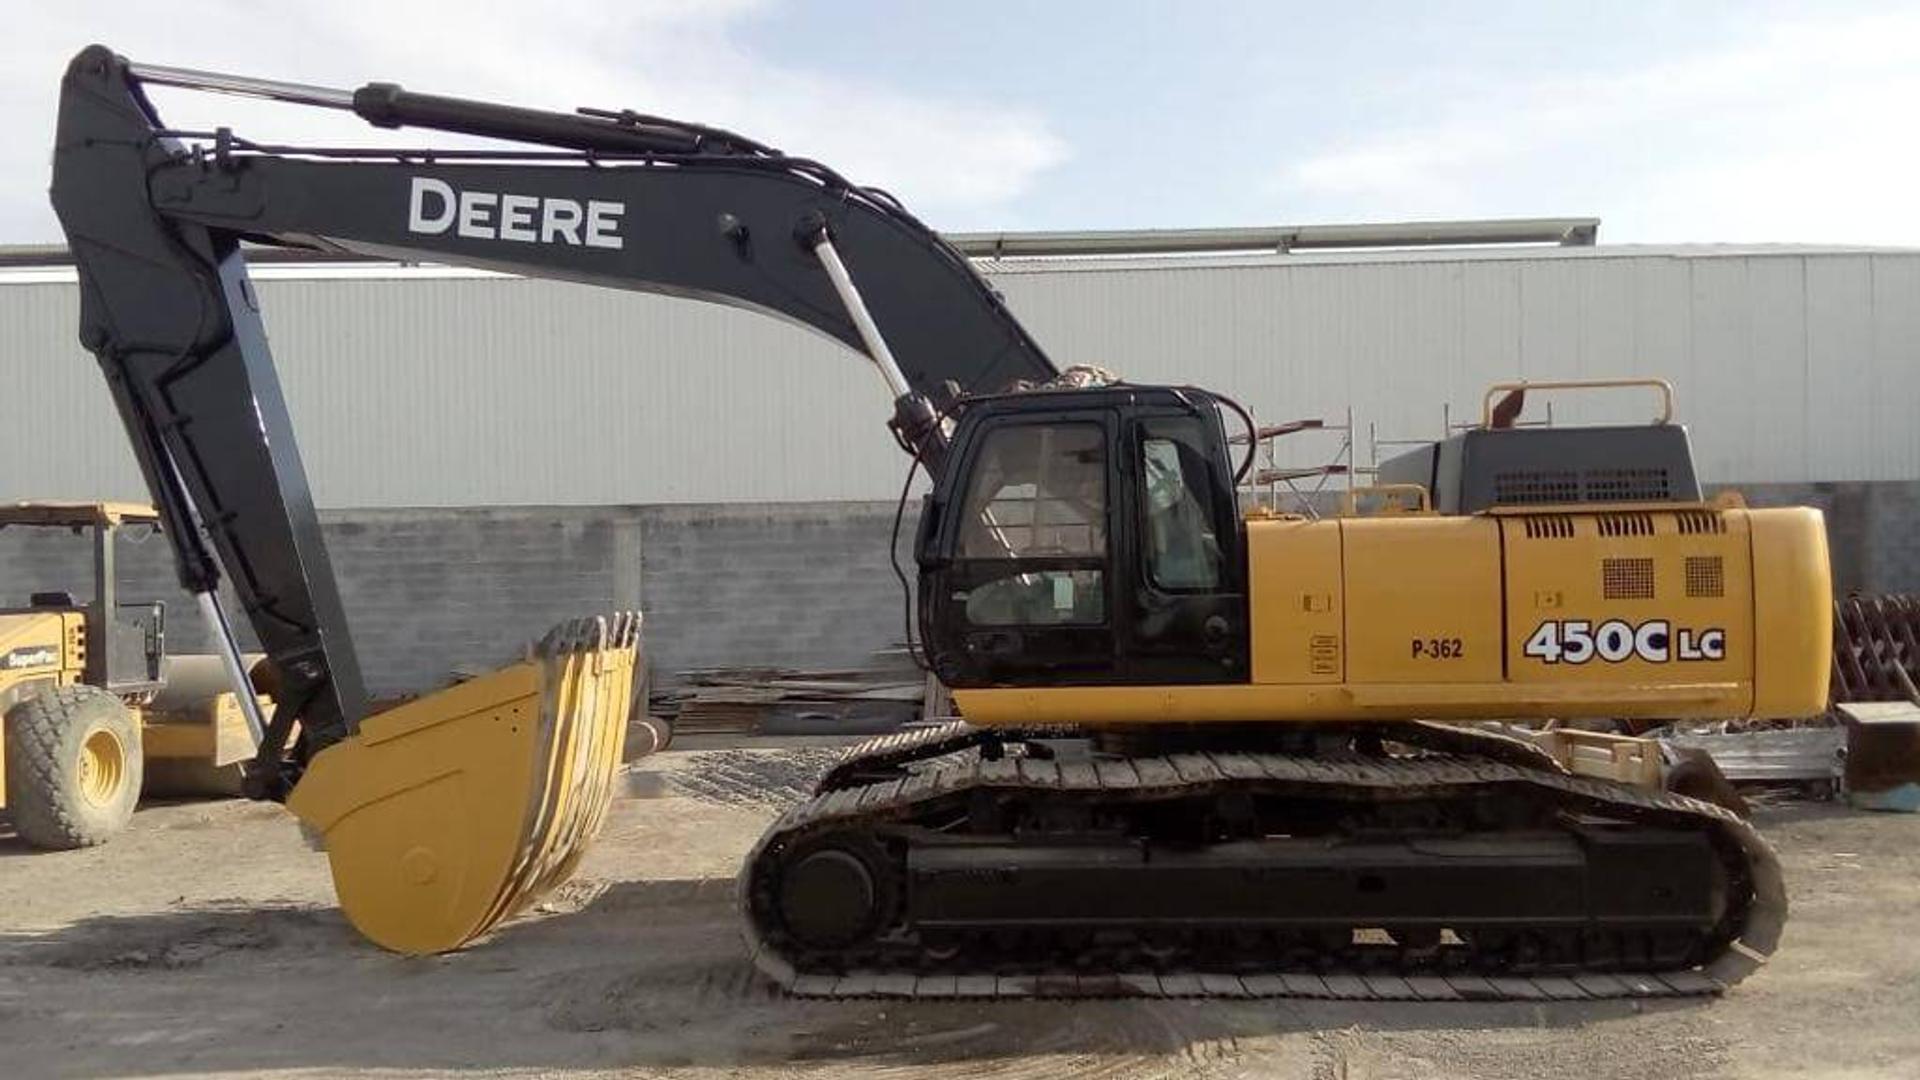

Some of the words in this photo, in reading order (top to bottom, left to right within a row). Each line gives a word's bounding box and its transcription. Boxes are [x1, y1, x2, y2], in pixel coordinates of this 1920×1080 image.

[409, 177, 624, 248] DEERE
[1412, 639, 1462, 659] P-362
[1524, 618, 1669, 664] 450C
[1677, 629, 1725, 661] LC
